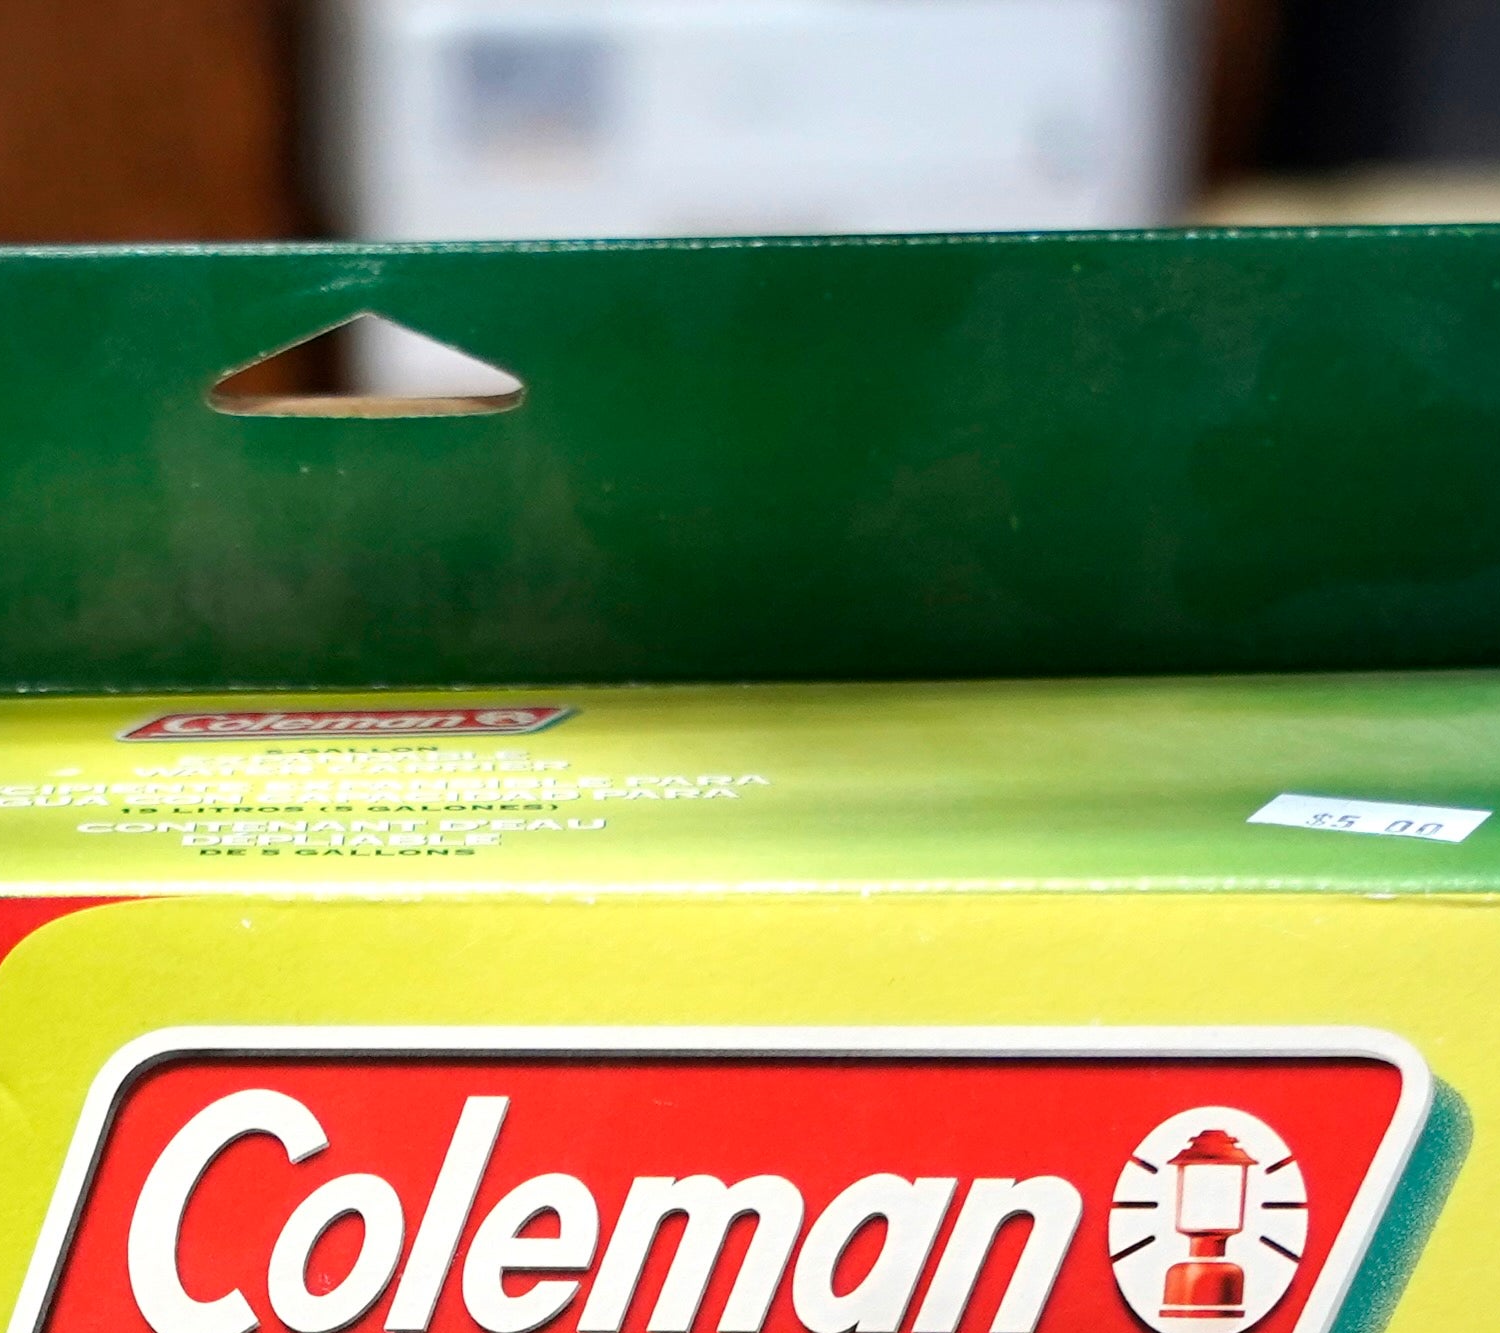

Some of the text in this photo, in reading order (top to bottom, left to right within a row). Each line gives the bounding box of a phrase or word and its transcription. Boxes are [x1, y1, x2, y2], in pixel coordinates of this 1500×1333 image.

[162, 713, 464, 732] Coleman
[625, 774, 770, 786] PARA
[124, 792, 243, 806] CON
[593, 787, 739, 801] PARA
[173, 806, 304, 814] LITROS
[319, 805, 353, 814] (5
[367, 804, 559, 812] GALONES)
[76, 818, 607, 834] CONTENANT D'EAU
[295, 848, 476, 856] GALLONS
